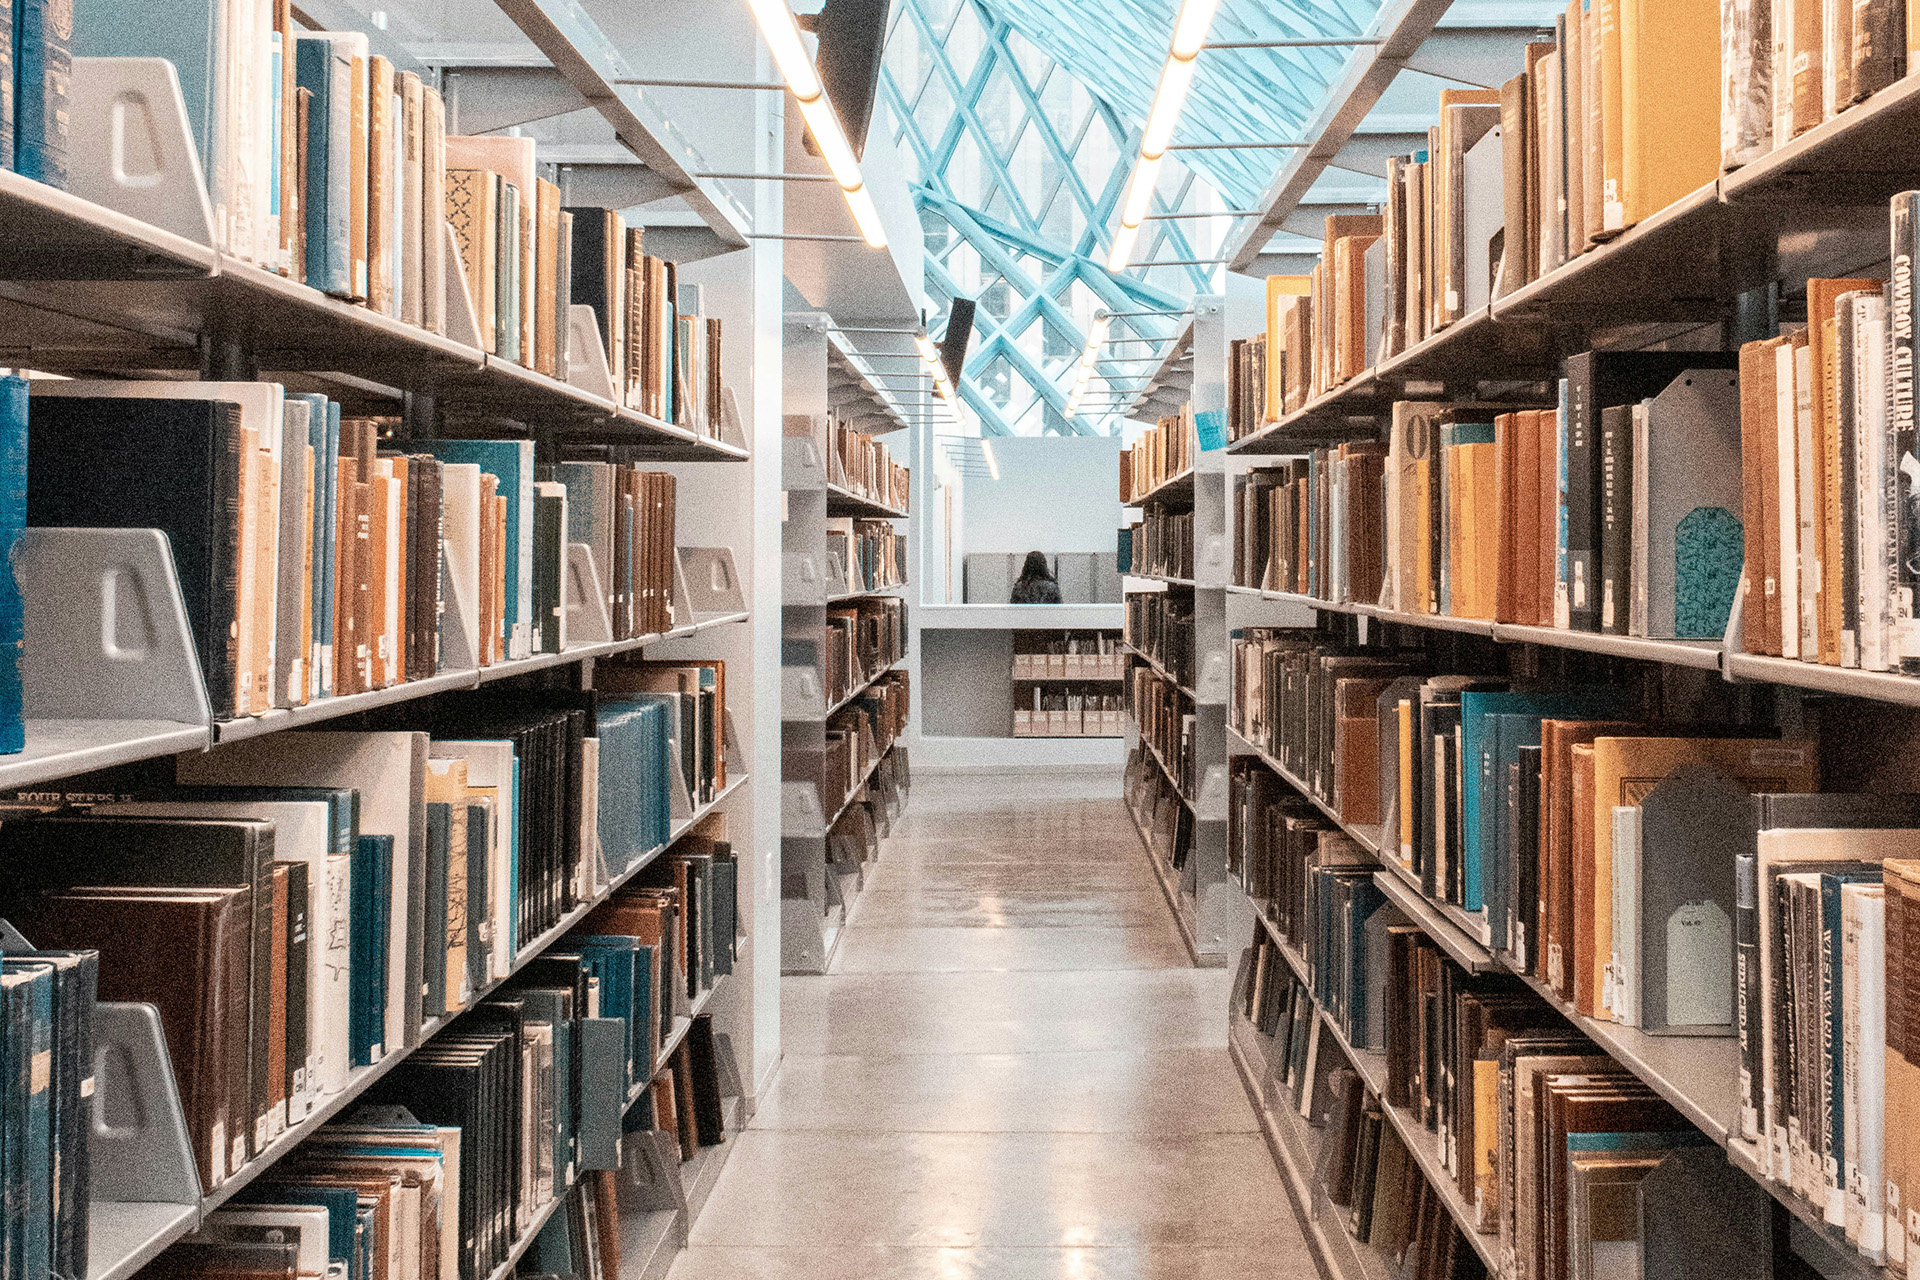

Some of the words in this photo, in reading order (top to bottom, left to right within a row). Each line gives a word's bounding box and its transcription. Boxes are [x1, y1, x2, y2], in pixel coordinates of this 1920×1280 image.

[1895, 254, 1913, 339] COWBOY
[1826, 352, 1834, 424] SOLDIER
[1894, 346, 1914, 432] CULTURE
[1887, 560, 1899, 595] WES
[1738, 953, 1747, 1026] SEDUCED
[1823, 929, 1833, 1049] WESTWARD
[1739, 1029, 1749, 1052] BY
[1824, 1053, 1834, 1157] EXPANSIO
